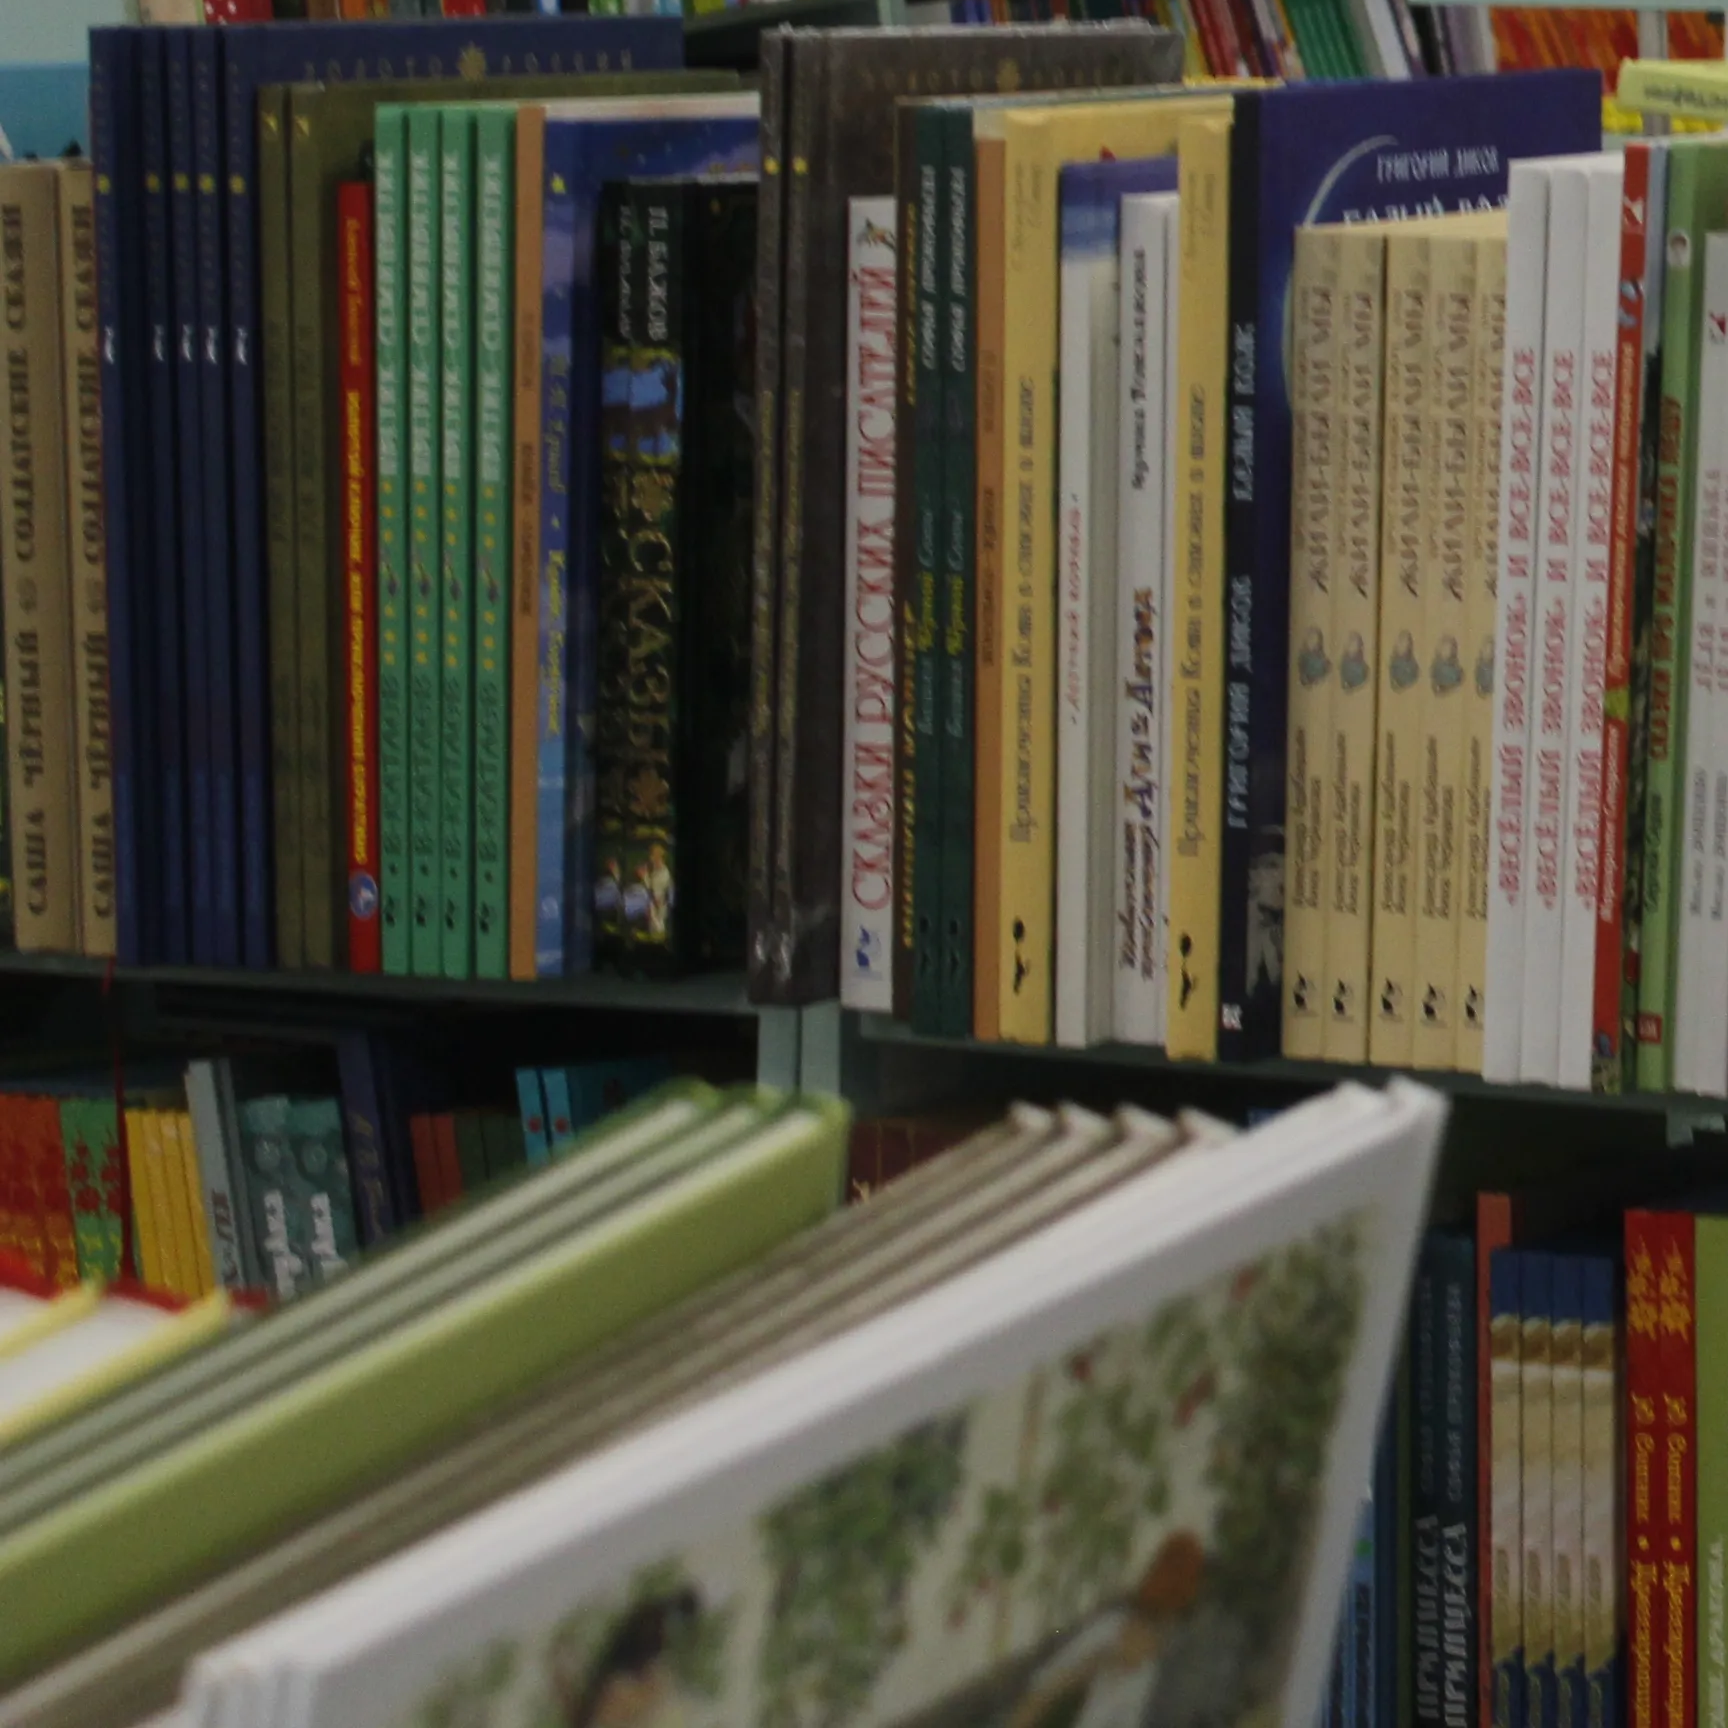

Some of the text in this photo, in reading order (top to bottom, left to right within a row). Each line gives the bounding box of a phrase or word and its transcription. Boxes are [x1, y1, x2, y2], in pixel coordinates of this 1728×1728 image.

[8, 348, 37, 564] СОЛДАТСКИЕ
[849, 265, 897, 912] СКАЗКИ РУССКИХ ПИСАТЕЛЕЙ
[1500, 344, 1535, 905] «ВЕСЁЛЫЙ ЗВОНОК» И ВСЕ-ВСЕ-ВСЕ
[1534, 349, 1575, 910] «ВЕСЁЛЫЙ ЗВОНОК» И ВСЕ-ВСЕ-ВСЕ
[14, 629, 45, 788] ЧЁРНЫЙ
[1228, 681, 1249, 829] ГРИГОРИЙ
[28, 808, 48, 915] САША
[1414, 1513, 1440, 1719] ПРИНЦЕССА
